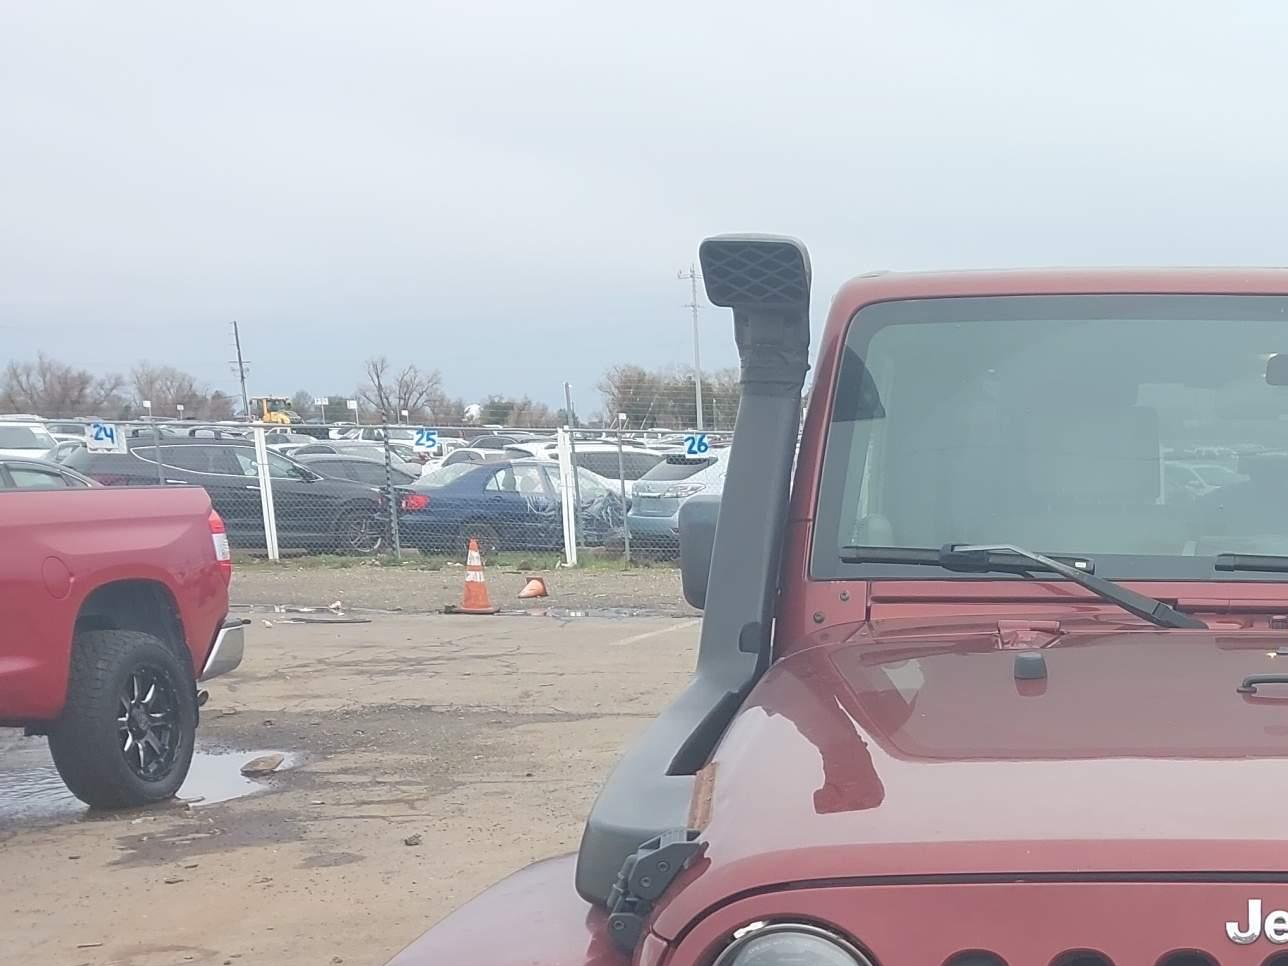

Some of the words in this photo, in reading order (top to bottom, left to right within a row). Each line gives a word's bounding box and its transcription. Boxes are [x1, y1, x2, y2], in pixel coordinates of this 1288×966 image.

[93, 424, 115, 444] 24
[415, 429, 438, 448] 25
[684, 434, 709, 454] 26
